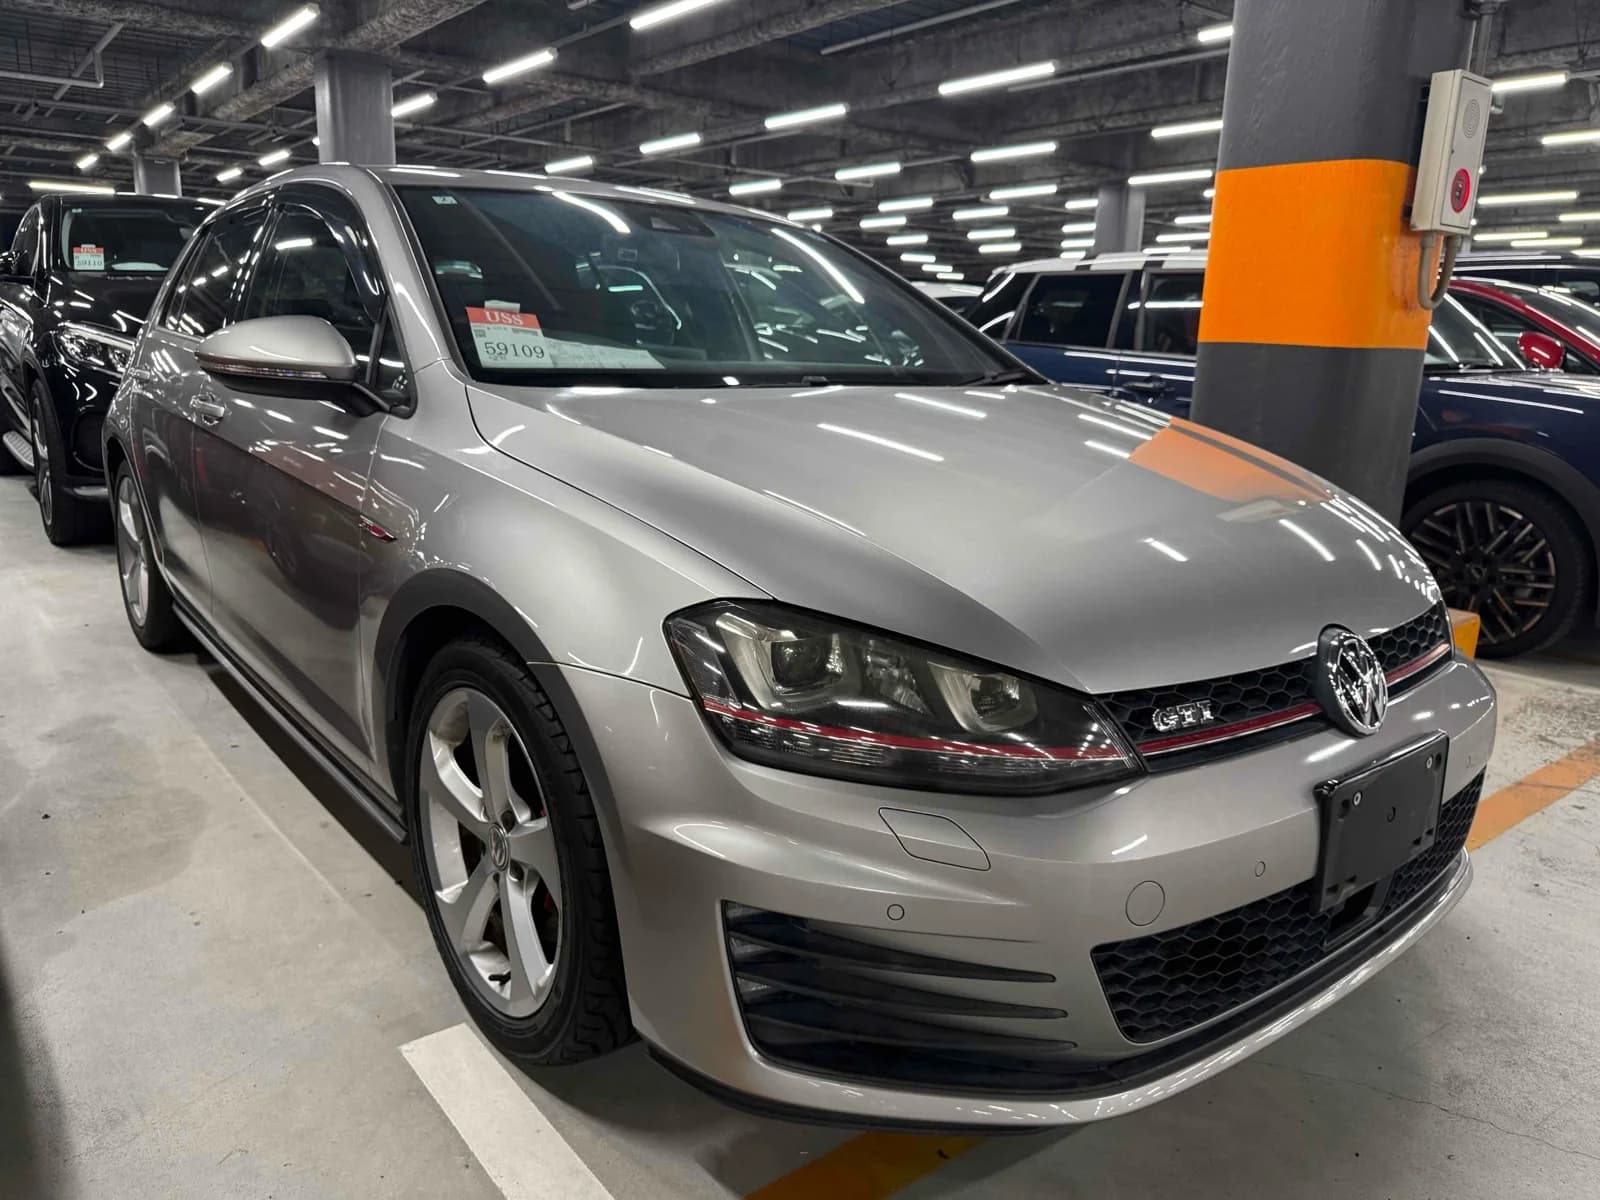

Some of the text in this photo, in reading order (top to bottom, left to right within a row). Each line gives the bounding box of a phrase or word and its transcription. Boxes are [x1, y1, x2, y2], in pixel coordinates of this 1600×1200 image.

[484, 310, 524, 326] USS
[484, 342, 545, 359] 59109
[1151, 700, 1214, 731] GTI
